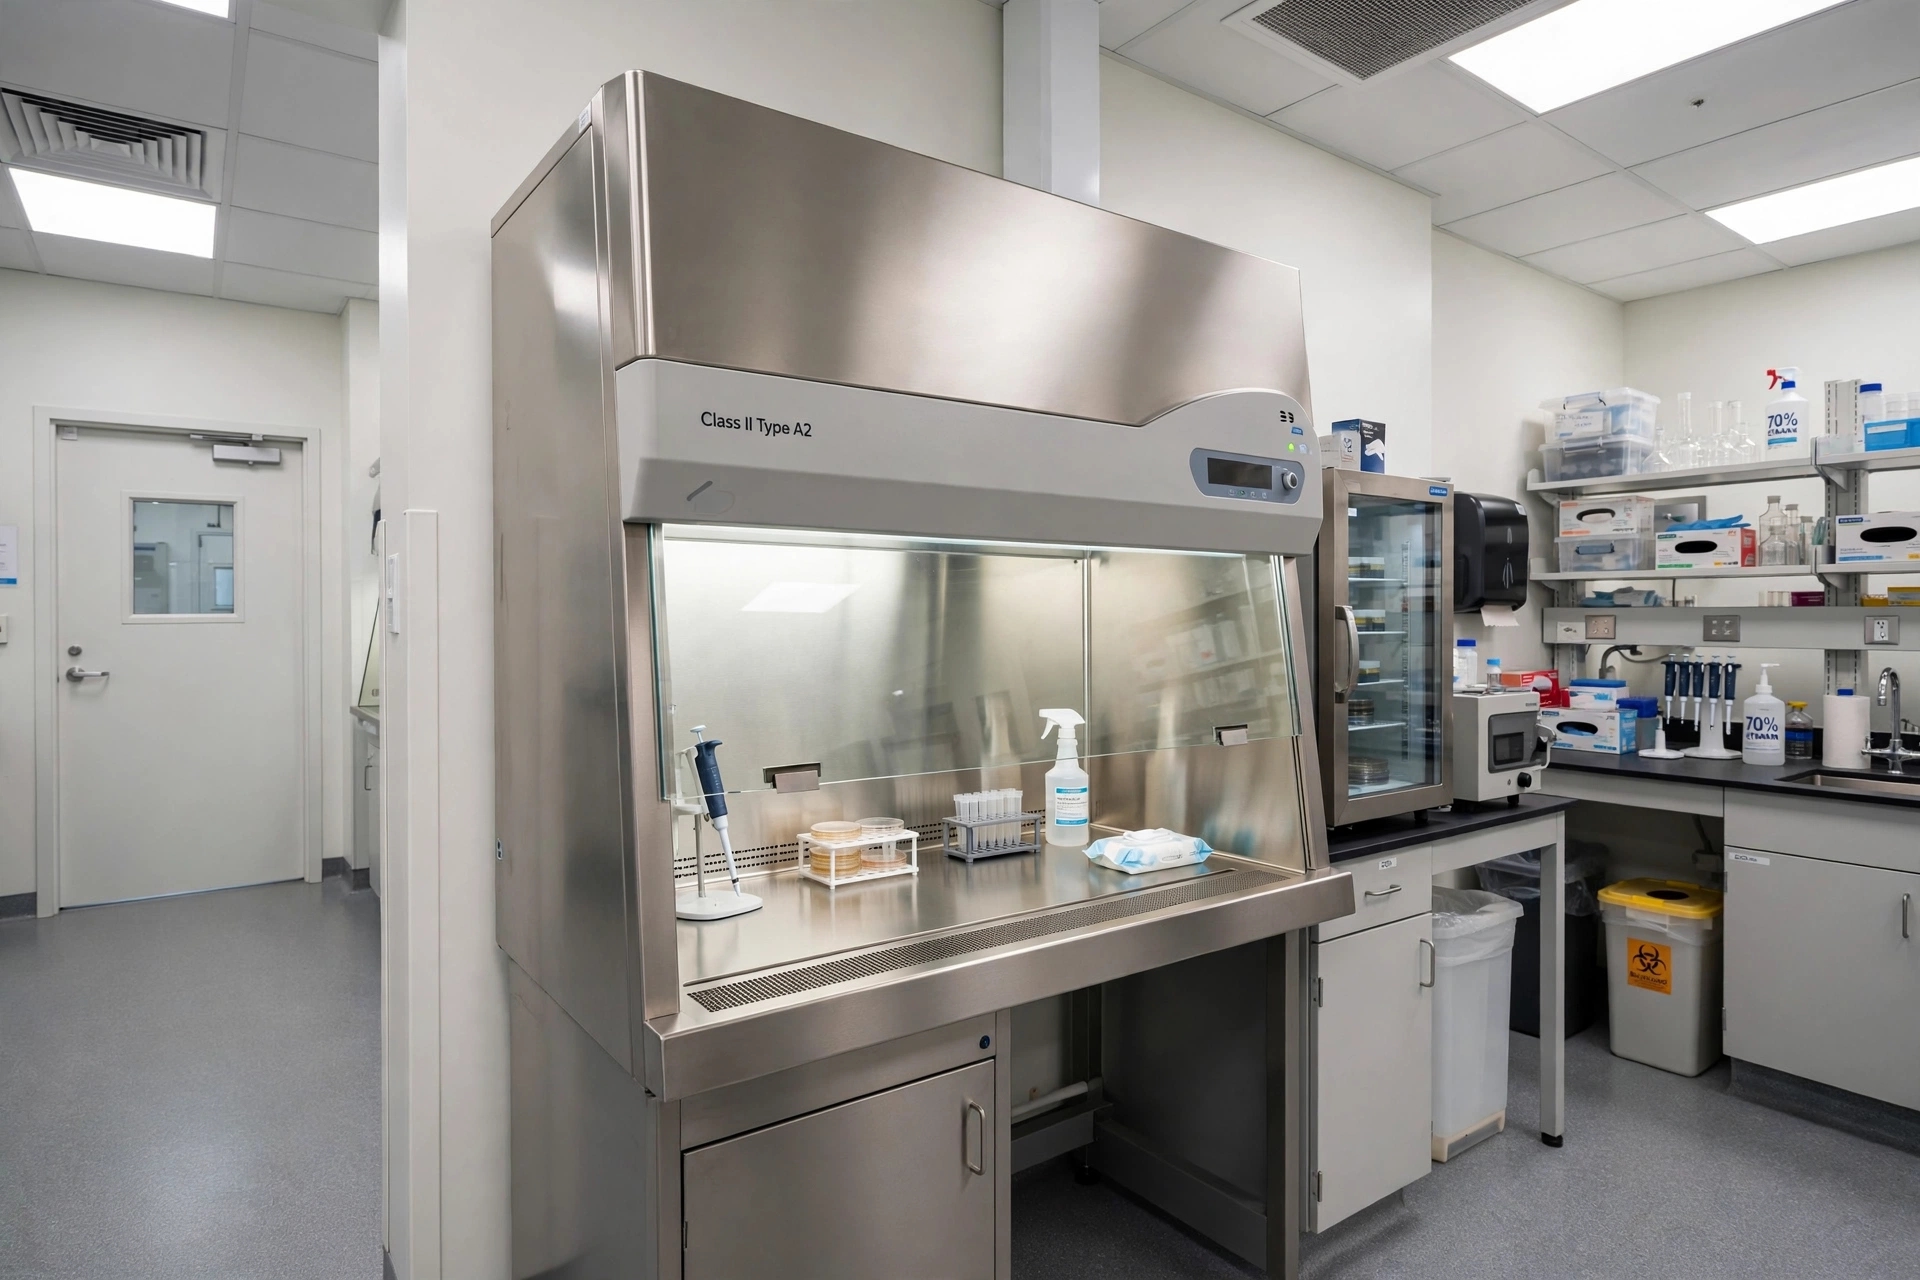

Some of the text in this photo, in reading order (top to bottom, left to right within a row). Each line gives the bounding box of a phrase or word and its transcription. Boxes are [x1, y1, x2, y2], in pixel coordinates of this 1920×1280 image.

[701, 411, 741, 430] Class
[756, 418, 790, 437] Type
[793, 422, 812, 437] A2
[1768, 412, 1798, 429] 70%
[1746, 716, 1778, 732] 70%
